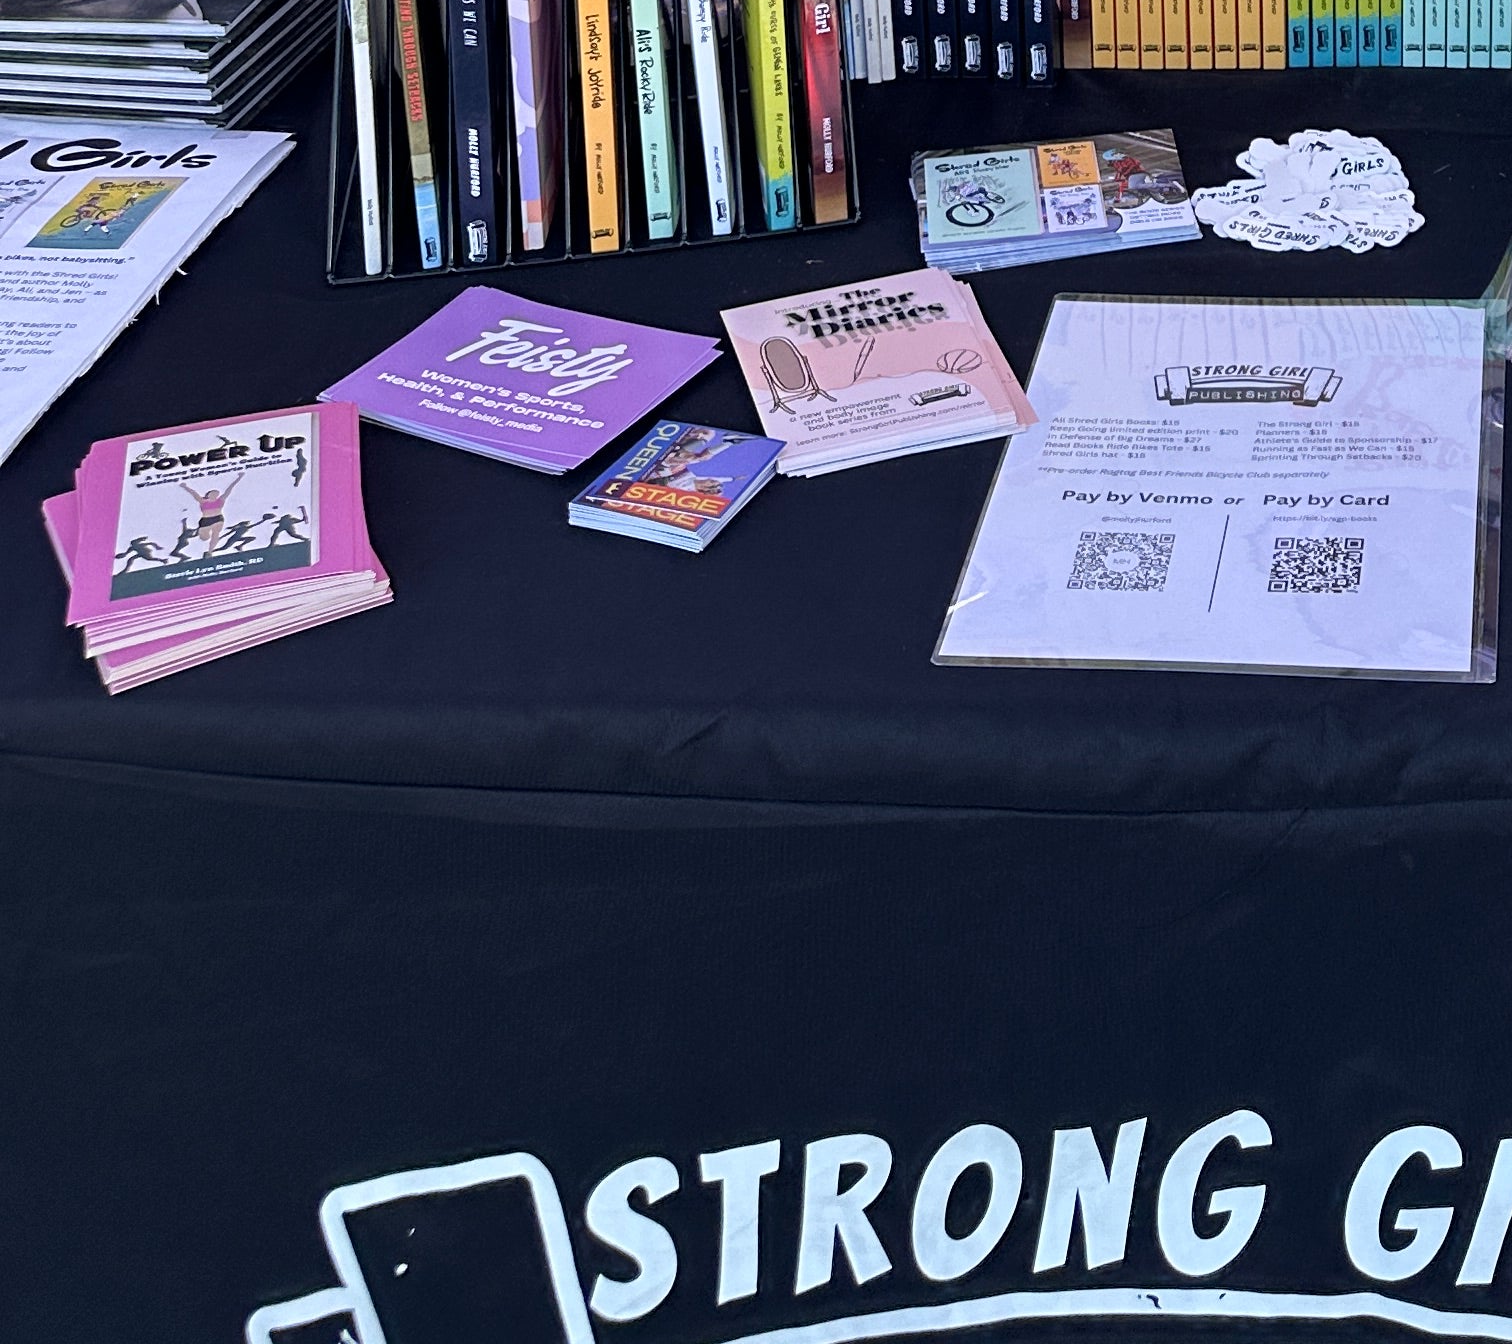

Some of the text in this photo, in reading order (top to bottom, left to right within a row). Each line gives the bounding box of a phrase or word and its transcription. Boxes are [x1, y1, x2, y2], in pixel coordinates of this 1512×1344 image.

[815, 4, 831, 35] Girl
[463, 27, 478, 46] CAN
[637, 55, 654, 90] Rocky
[30, 138, 217, 172] Girls
[1342, 158, 1384, 175] GIRLS
[784, 290, 915, 326] Mirror
[838, 286, 881, 301] The
[811, 302, 945, 338] Diaries
[445, 319, 633, 396] Feisty
[1191, 365, 1307, 378] STRONG GIRL
[377, 372, 605, 429] Health, & Performance
[418, 399, 458, 414] Follow
[421, 369, 586, 414] Women's Sports,
[1188, 390, 1301, 401] PUBLISHING
[129, 434, 306, 476] POWER UP
[616, 423, 681, 480] QUEEN
[626, 486, 727, 513] STAGE
[1062, 490, 1245, 506] Pay by Venmo or
[1263, 494, 1390, 508] Pay by Card
[584, 1107, 1273, 1314] STRONG
